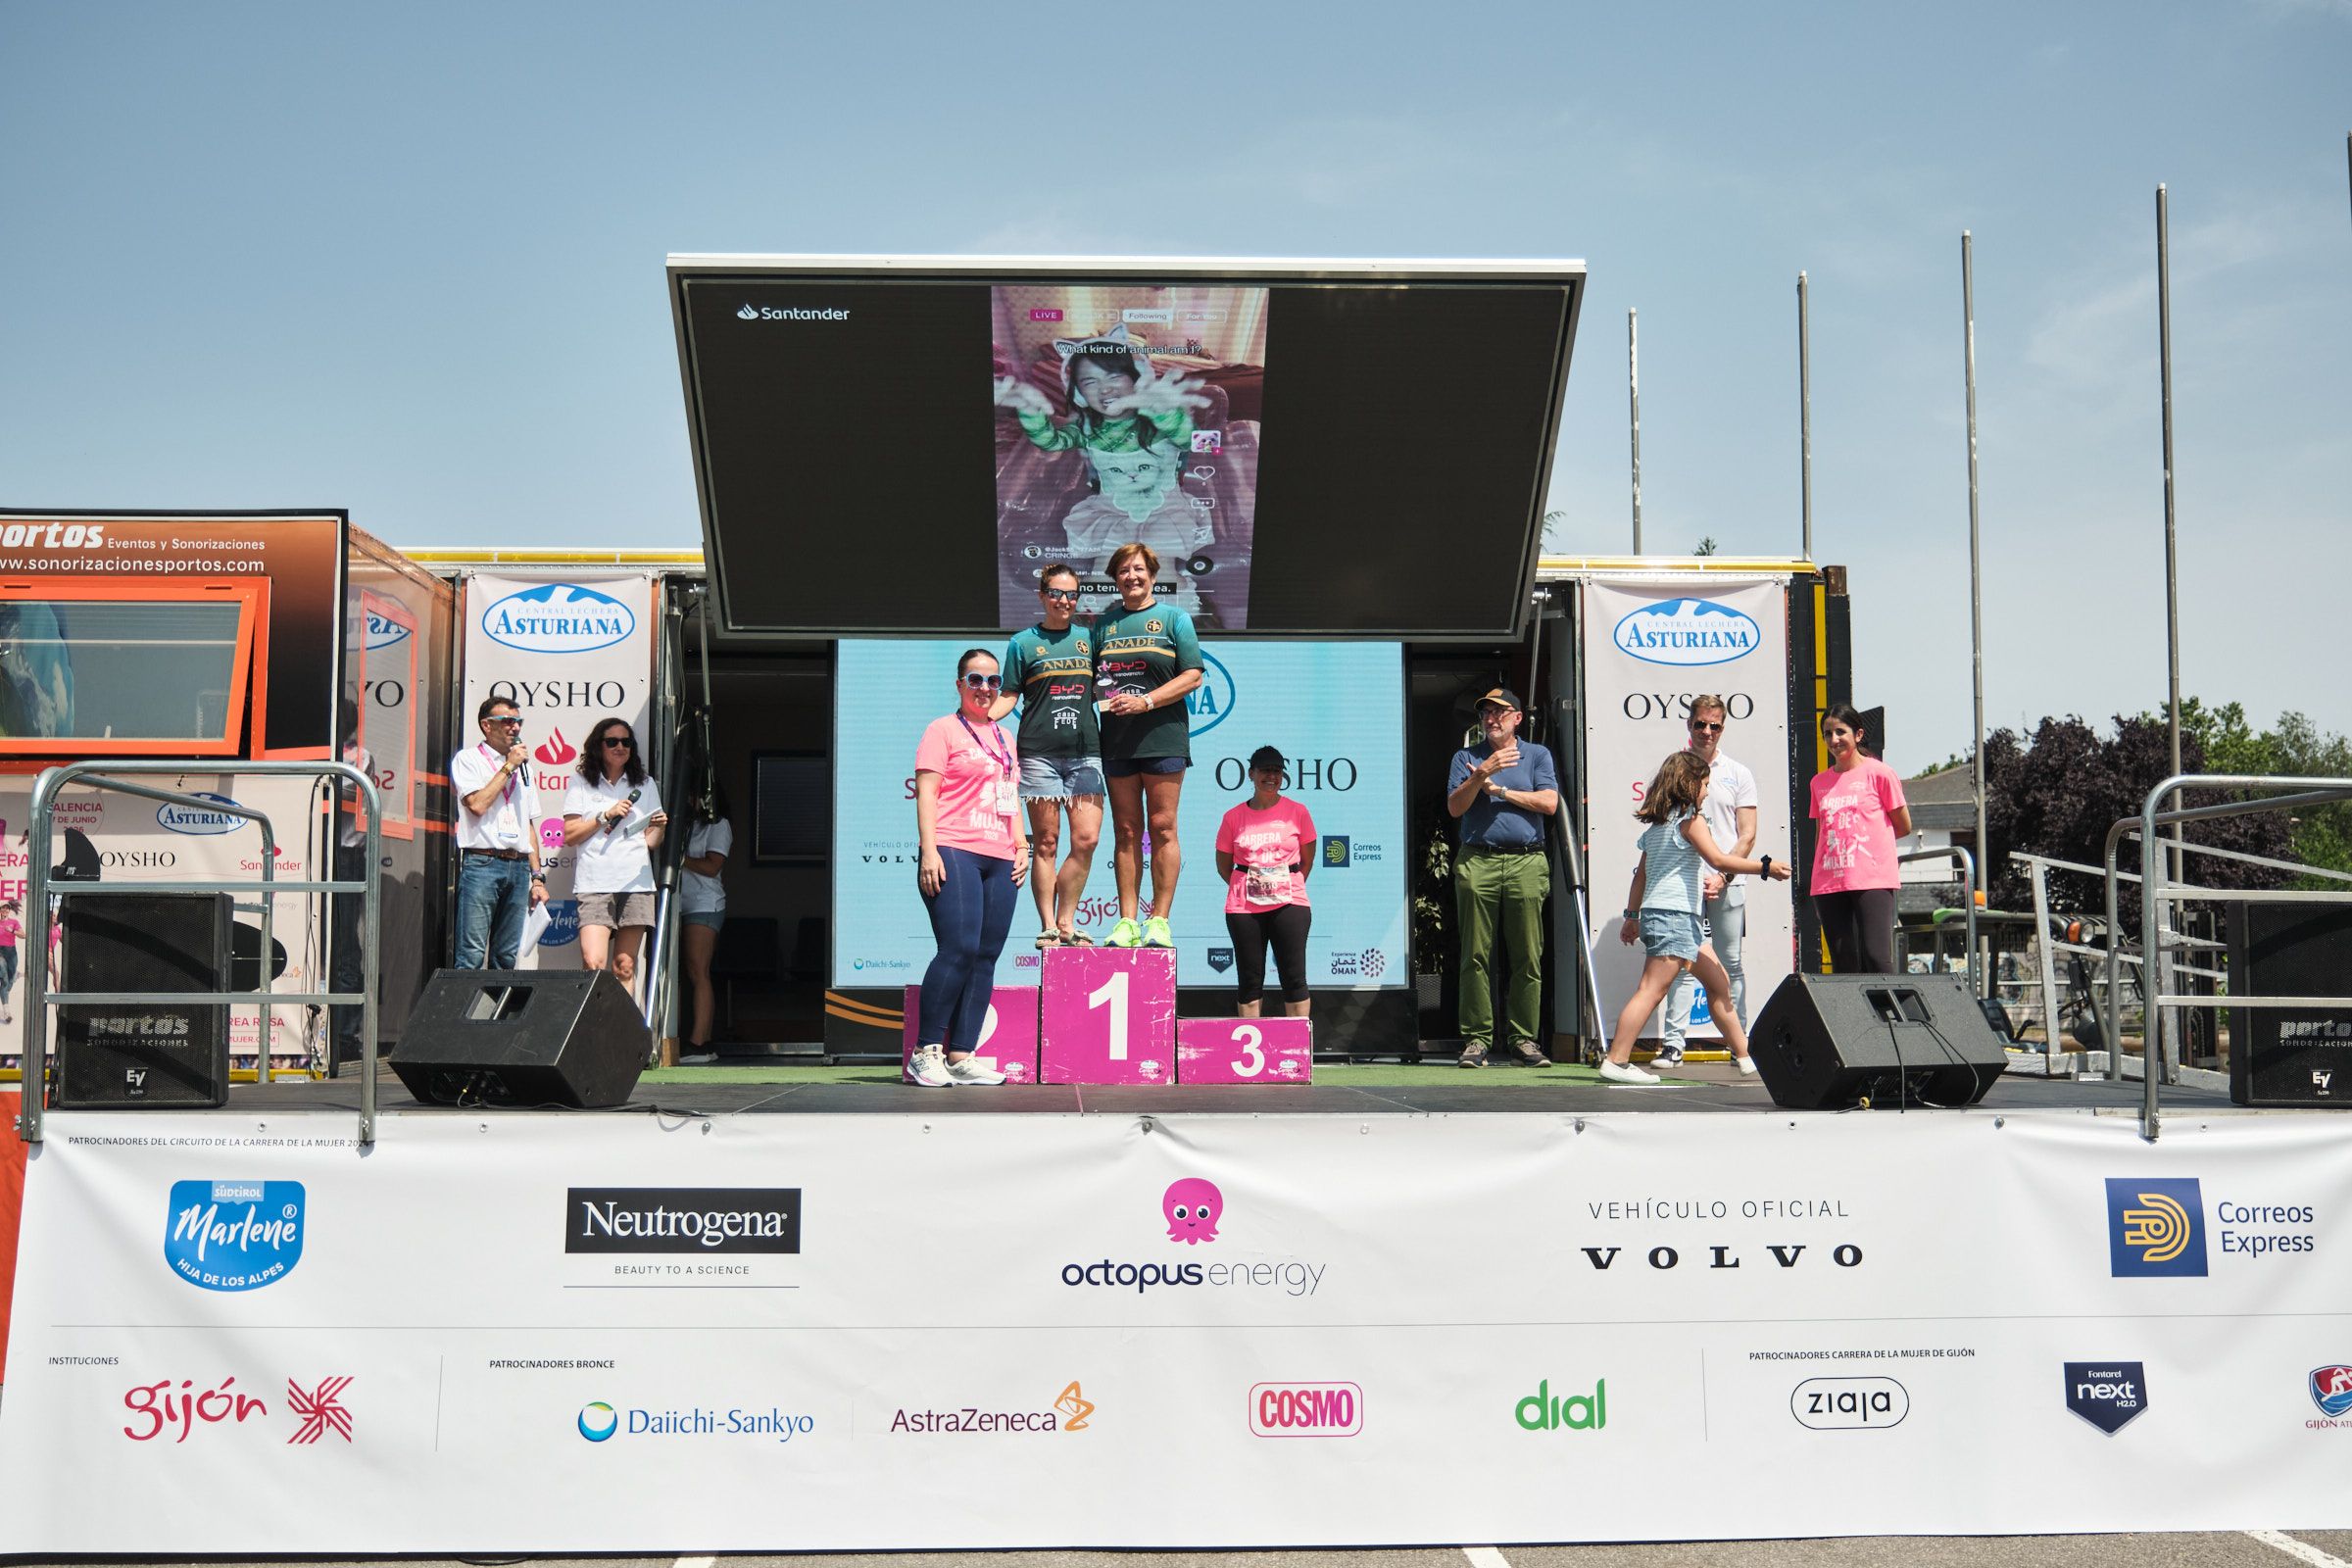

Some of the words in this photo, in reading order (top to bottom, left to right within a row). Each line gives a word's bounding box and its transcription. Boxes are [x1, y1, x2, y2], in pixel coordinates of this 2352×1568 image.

[760, 307, 850, 320] Santander
[1057, 344, 1086, 354] What
[1090, 344, 1113, 354] kind
[1116, 344, 1126, 354] of
[1129, 345, 1167, 355] animal
[1170, 346, 1187, 355] am
[0, 522, 104, 549] ortos
[108, 538, 156, 550] Eventos
[161, 541, 167, 551] y
[172, 538, 266, 551] Sonorizaciones
[494, 610, 623, 634] ASTURIANA
[1104, 638, 1155, 650] ANADE
[1625, 622, 1750, 648] ASTURIANA
[1111, 661, 1147, 671] BYD
[490, 680, 625, 709] OYSHO
[1050, 684, 1085, 694] BYD
[1623, 693, 1754, 720] OYSO
[1215, 758, 1357, 791] OSHO
[53, 803, 103, 812] ALENCIA
[100, 852, 175, 867] OYSHO
[240, 859, 302, 871] Sannder
[1823, 855, 1855, 871] MUJER
[1076, 896, 1119, 926] gijó
[1015, 956, 1040, 967] COSMO
[253, 1017, 284, 1026] RSA
[1089, 972, 1129, 1059] 1
[1231, 1025, 1265, 1077] 3
[126, 1069, 146, 1087] EV
[2312, 1071, 2331, 1088] EV
[69, 1137, 148, 1146] PATROCINADORES
[151, 1137, 168, 1146] DEL
[170, 1137, 213, 1146] CIRCUITO
[215, 1138, 226, 1147] DE
[229, 1138, 241, 1147] LA
[243, 1138, 284, 1147] CARRERA
[1589, 1198, 1727, 1219] VEHÍCULO
[1742, 1200, 1848, 1218] OFICIAL
[2218, 1201, 2314, 1224] Correos
[2221, 1231, 2314, 1258] Express
[1581, 1244, 1863, 1270] VOLVO
[177, 1258, 200, 1279] HIJA
[202, 1273, 219, 1285] DE
[221, 1276, 245, 1286] LOS
[248, 1262, 284, 1285] ALPES
[614, 1265, 662, 1274] BEAUTY
[666, 1265, 681, 1274] TO
[685, 1265, 693, 1274] A
[698, 1265, 750, 1274] SCIENCE
[48, 1356, 119, 1365] INSTITUCIONES
[1749, 1351, 1830, 1360] PATROCINADORES
[1900, 1349, 1931, 1358] MUJER
[1933, 1349, 1945, 1358] DE
[1946, 1348, 1975, 1357] GIJÓN
[489, 1360, 574, 1369] PATROCINADORES
[576, 1360, 614, 1369] BRONCE
[2078, 1381, 2135, 1398] next
[123, 1377, 267, 1443] gijón
[1259, 1389, 1354, 1428] COSMO
[1515, 1378, 1606, 1430] dial
[1808, 1392, 1890, 1421] ziaja
[628, 1408, 814, 1443] Daiichi-Sankyo
[891, 1408, 1056, 1432] AstraZeneca
[2305, 1417, 2337, 1430] GIJÓN
